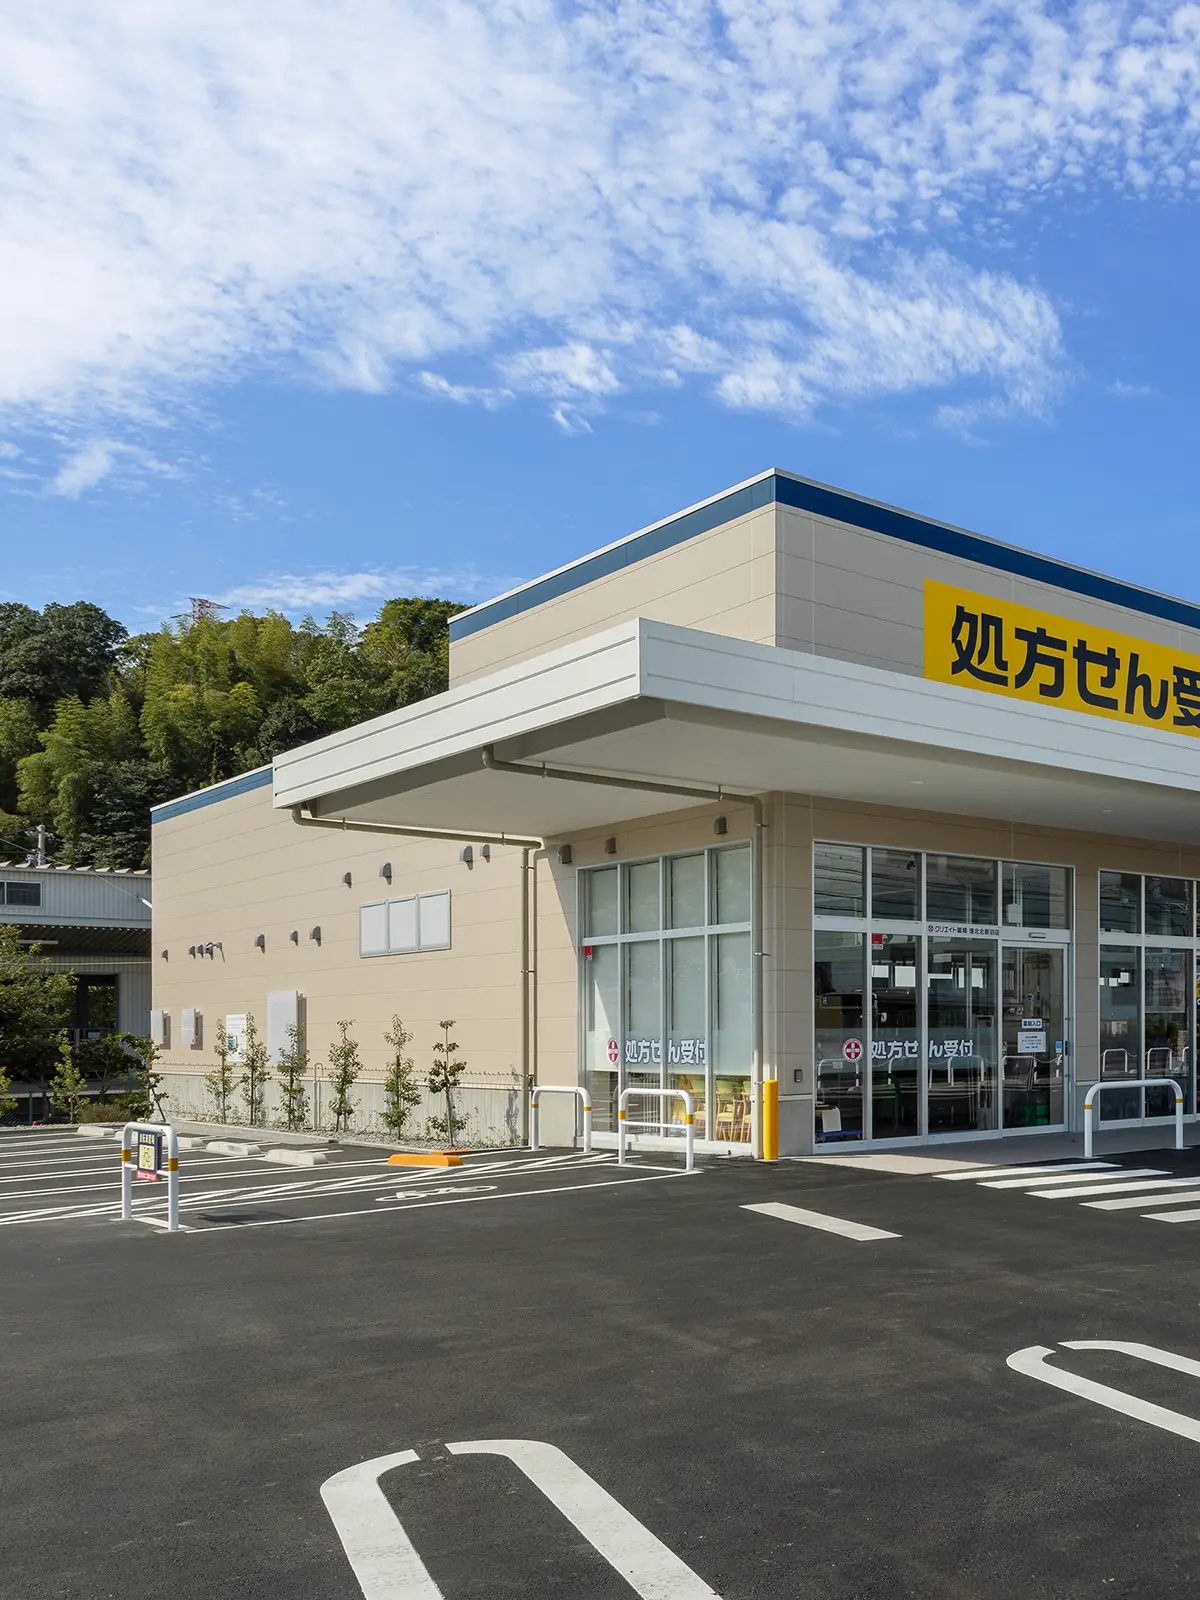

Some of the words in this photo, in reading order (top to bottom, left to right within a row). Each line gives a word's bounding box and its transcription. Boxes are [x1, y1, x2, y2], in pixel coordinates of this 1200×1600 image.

[934, 925, 967, 934] クリエイト薬局
[871, 1039, 974, 1060] 処方せん受付
